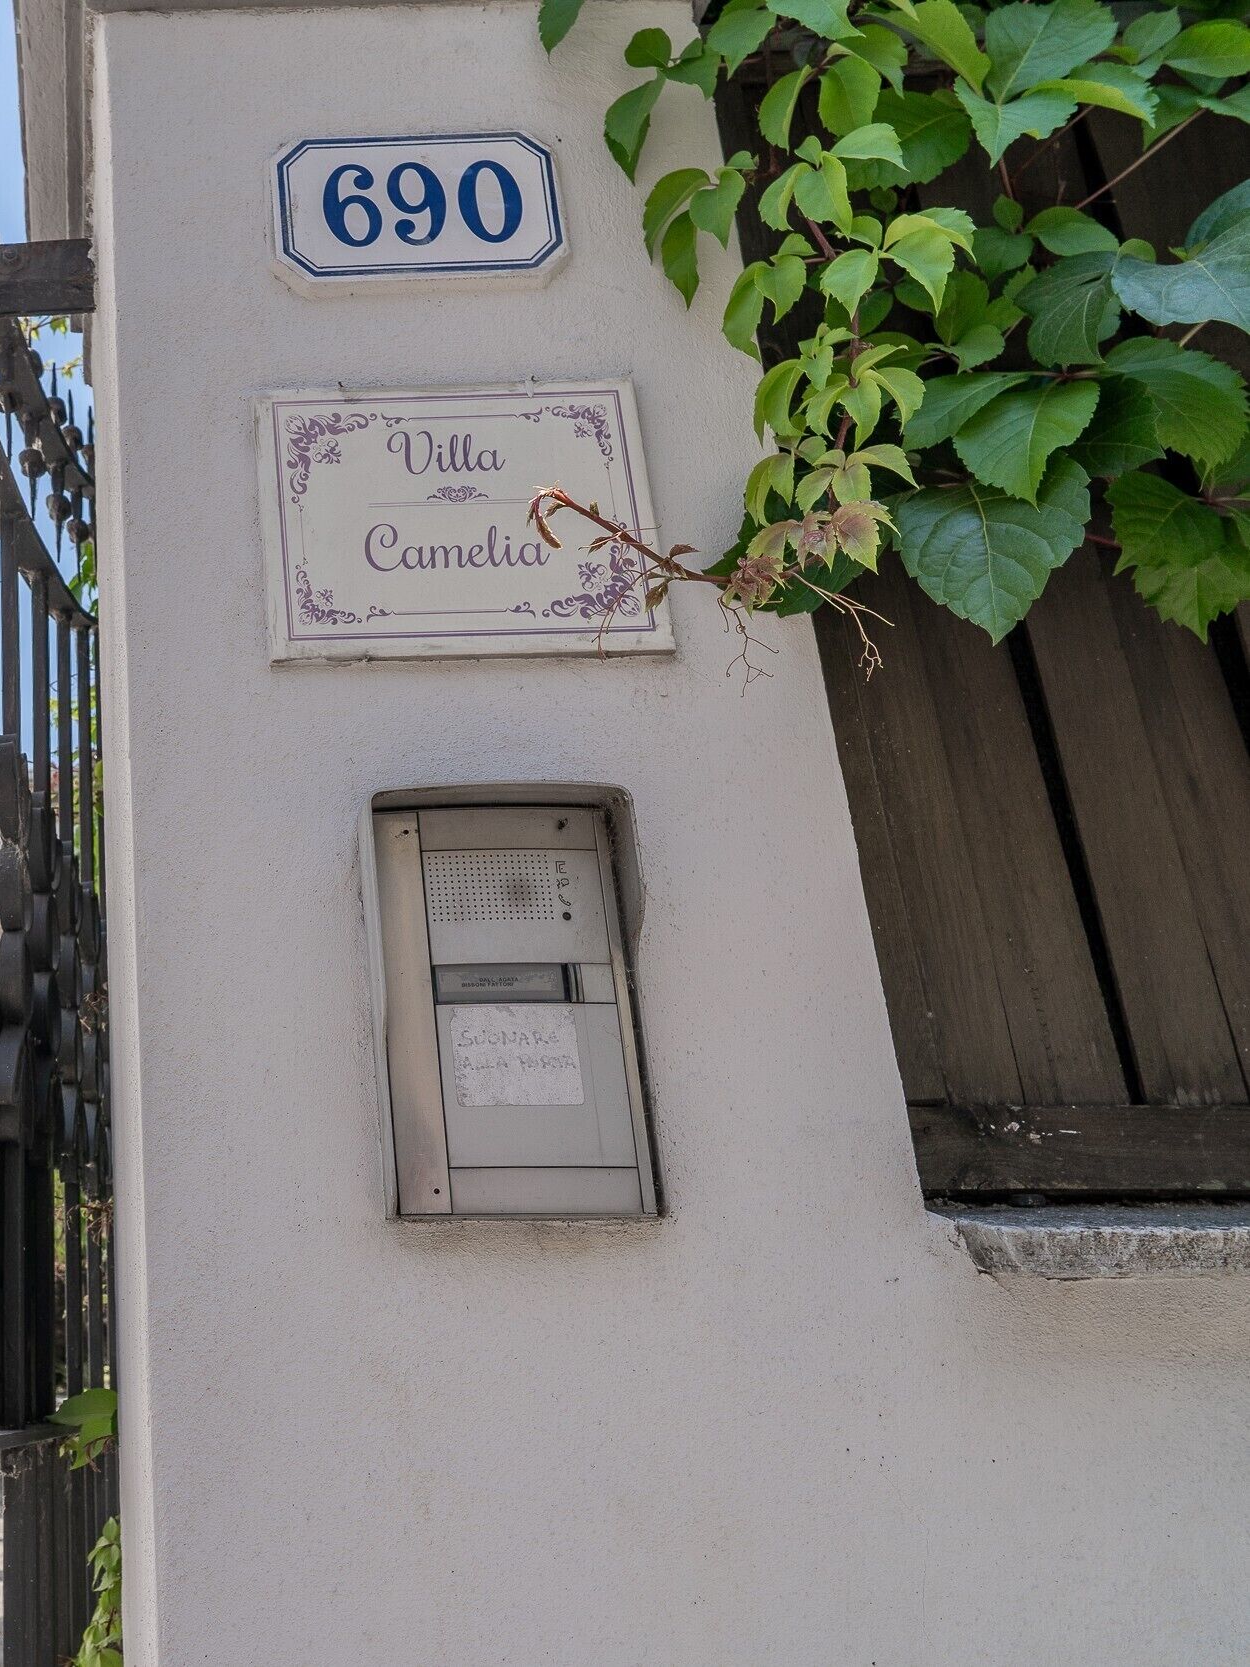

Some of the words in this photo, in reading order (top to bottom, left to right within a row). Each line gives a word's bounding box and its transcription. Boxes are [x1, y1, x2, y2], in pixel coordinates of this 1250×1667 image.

[322, 159, 524, 248] 690
[386, 430, 506, 476] Villa
[363, 522, 552, 573] Camelia
